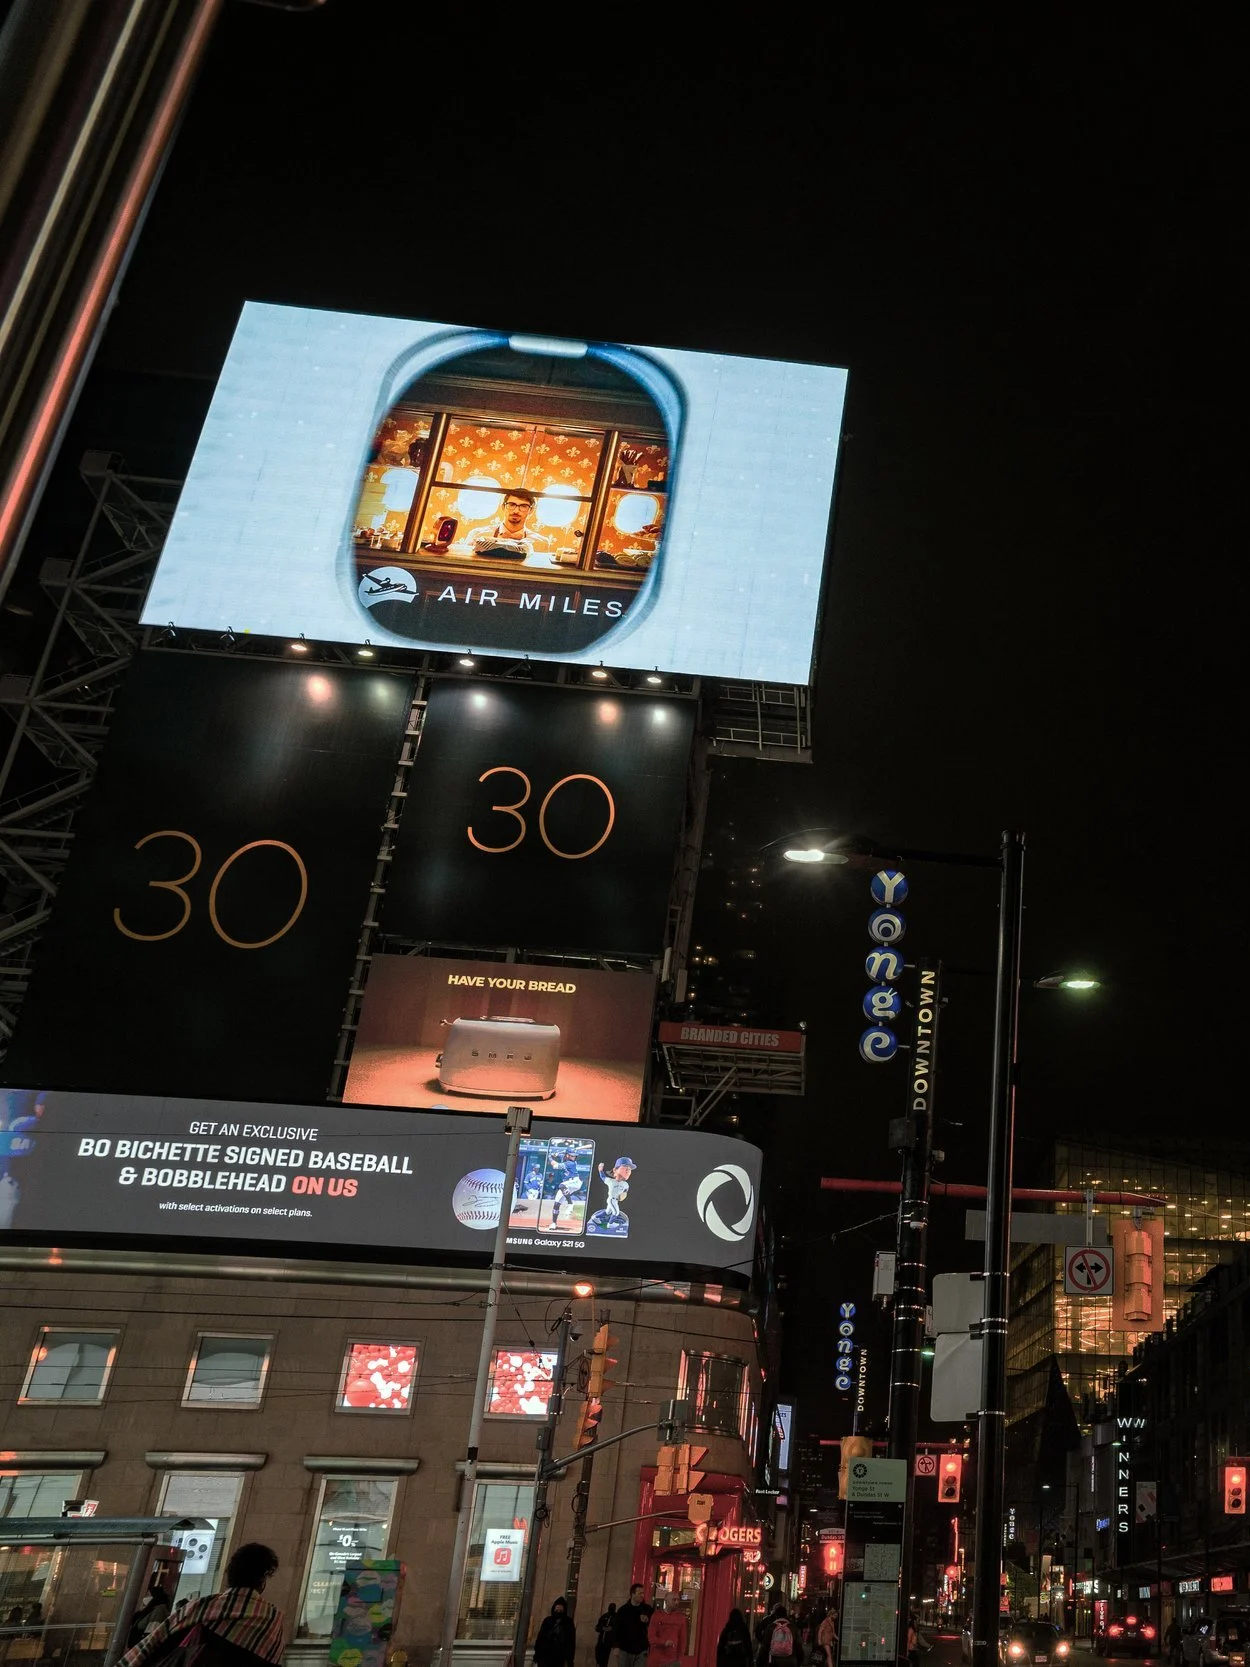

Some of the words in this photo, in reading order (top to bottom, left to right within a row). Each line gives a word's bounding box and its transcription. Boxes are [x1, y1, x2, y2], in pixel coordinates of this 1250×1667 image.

[438, 585, 499, 607] AIR
[519, 592, 624, 619] MILES
[467, 766, 617, 860] 30
[113, 830, 309, 949] 30
[448, 974, 486, 988] HAVE
[487, 976, 526, 991] YOUR
[527, 980, 577, 994] BREAD
[680, 1026, 739, 1044] BRANDED
[740, 1031, 780, 1047] CITIES
[912, 969, 936, 1111] DOWNTOWN
[189, 1121, 218, 1136] GET
[219, 1123, 239, 1137] AN
[242, 1125, 319, 1141] EXCLUSIVE
[78, 1138, 112, 1158] BO
[114, 1139, 221, 1163] BICHETTE
[223, 1145, 305, 1168] SIGNED
[307, 1150, 414, 1175] BASEBALL
[118, 1167, 138, 1186] &
[141, 1168, 288, 1193] BOBBLEHEAD
[291, 1175, 326, 1196] ON
[327, 1177, 359, 1197] US
[159, 1202, 177, 1211] with
[178, 1202, 204, 1213] select
[205, 1203, 249, 1215] activations
[251, 1207, 262, 1216] on
[263, 1206, 288, 1217] select
[288, 1208, 313, 1219] plans.
[534, 1238, 561, 1249] Galaxy
[561, 1239, 574, 1248] S21
[574, 1240, 585, 1248] 5G
[857, 1348, 868, 1412] DOWNTOWN
[1117, 1417, 1132, 1533] WINNERS
[719, 1527, 761, 1542] OGERS
